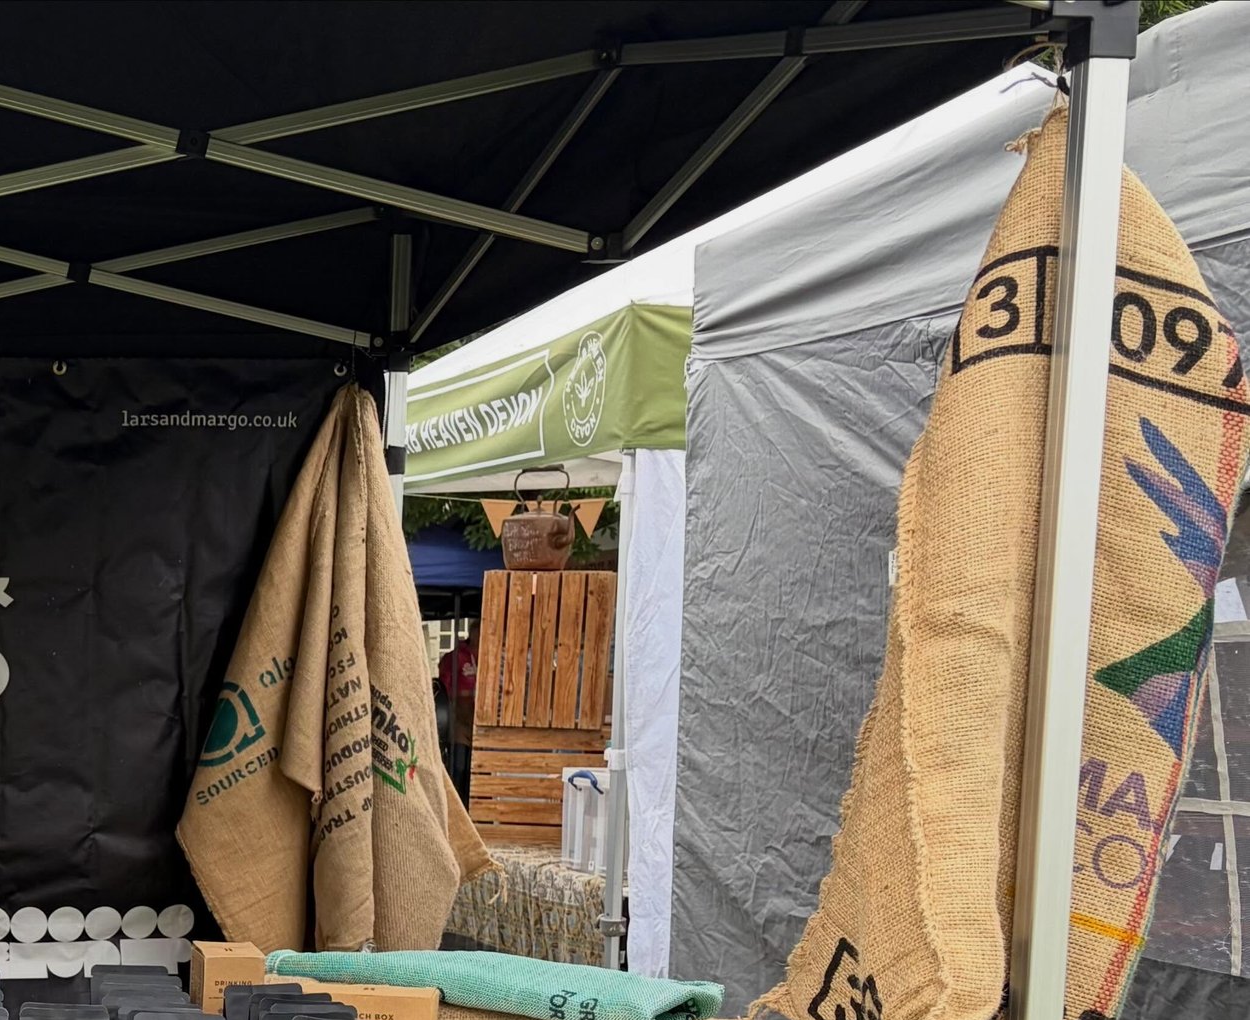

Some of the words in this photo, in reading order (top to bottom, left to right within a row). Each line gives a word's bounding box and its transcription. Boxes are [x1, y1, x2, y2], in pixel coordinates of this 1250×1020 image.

[121, 410, 297, 430] larsandmargo.co.uk
[420, 406, 484, 450] HEAVEN
[478, 387, 543, 437] DEVON
[196, 747, 279, 805] SOURCED
